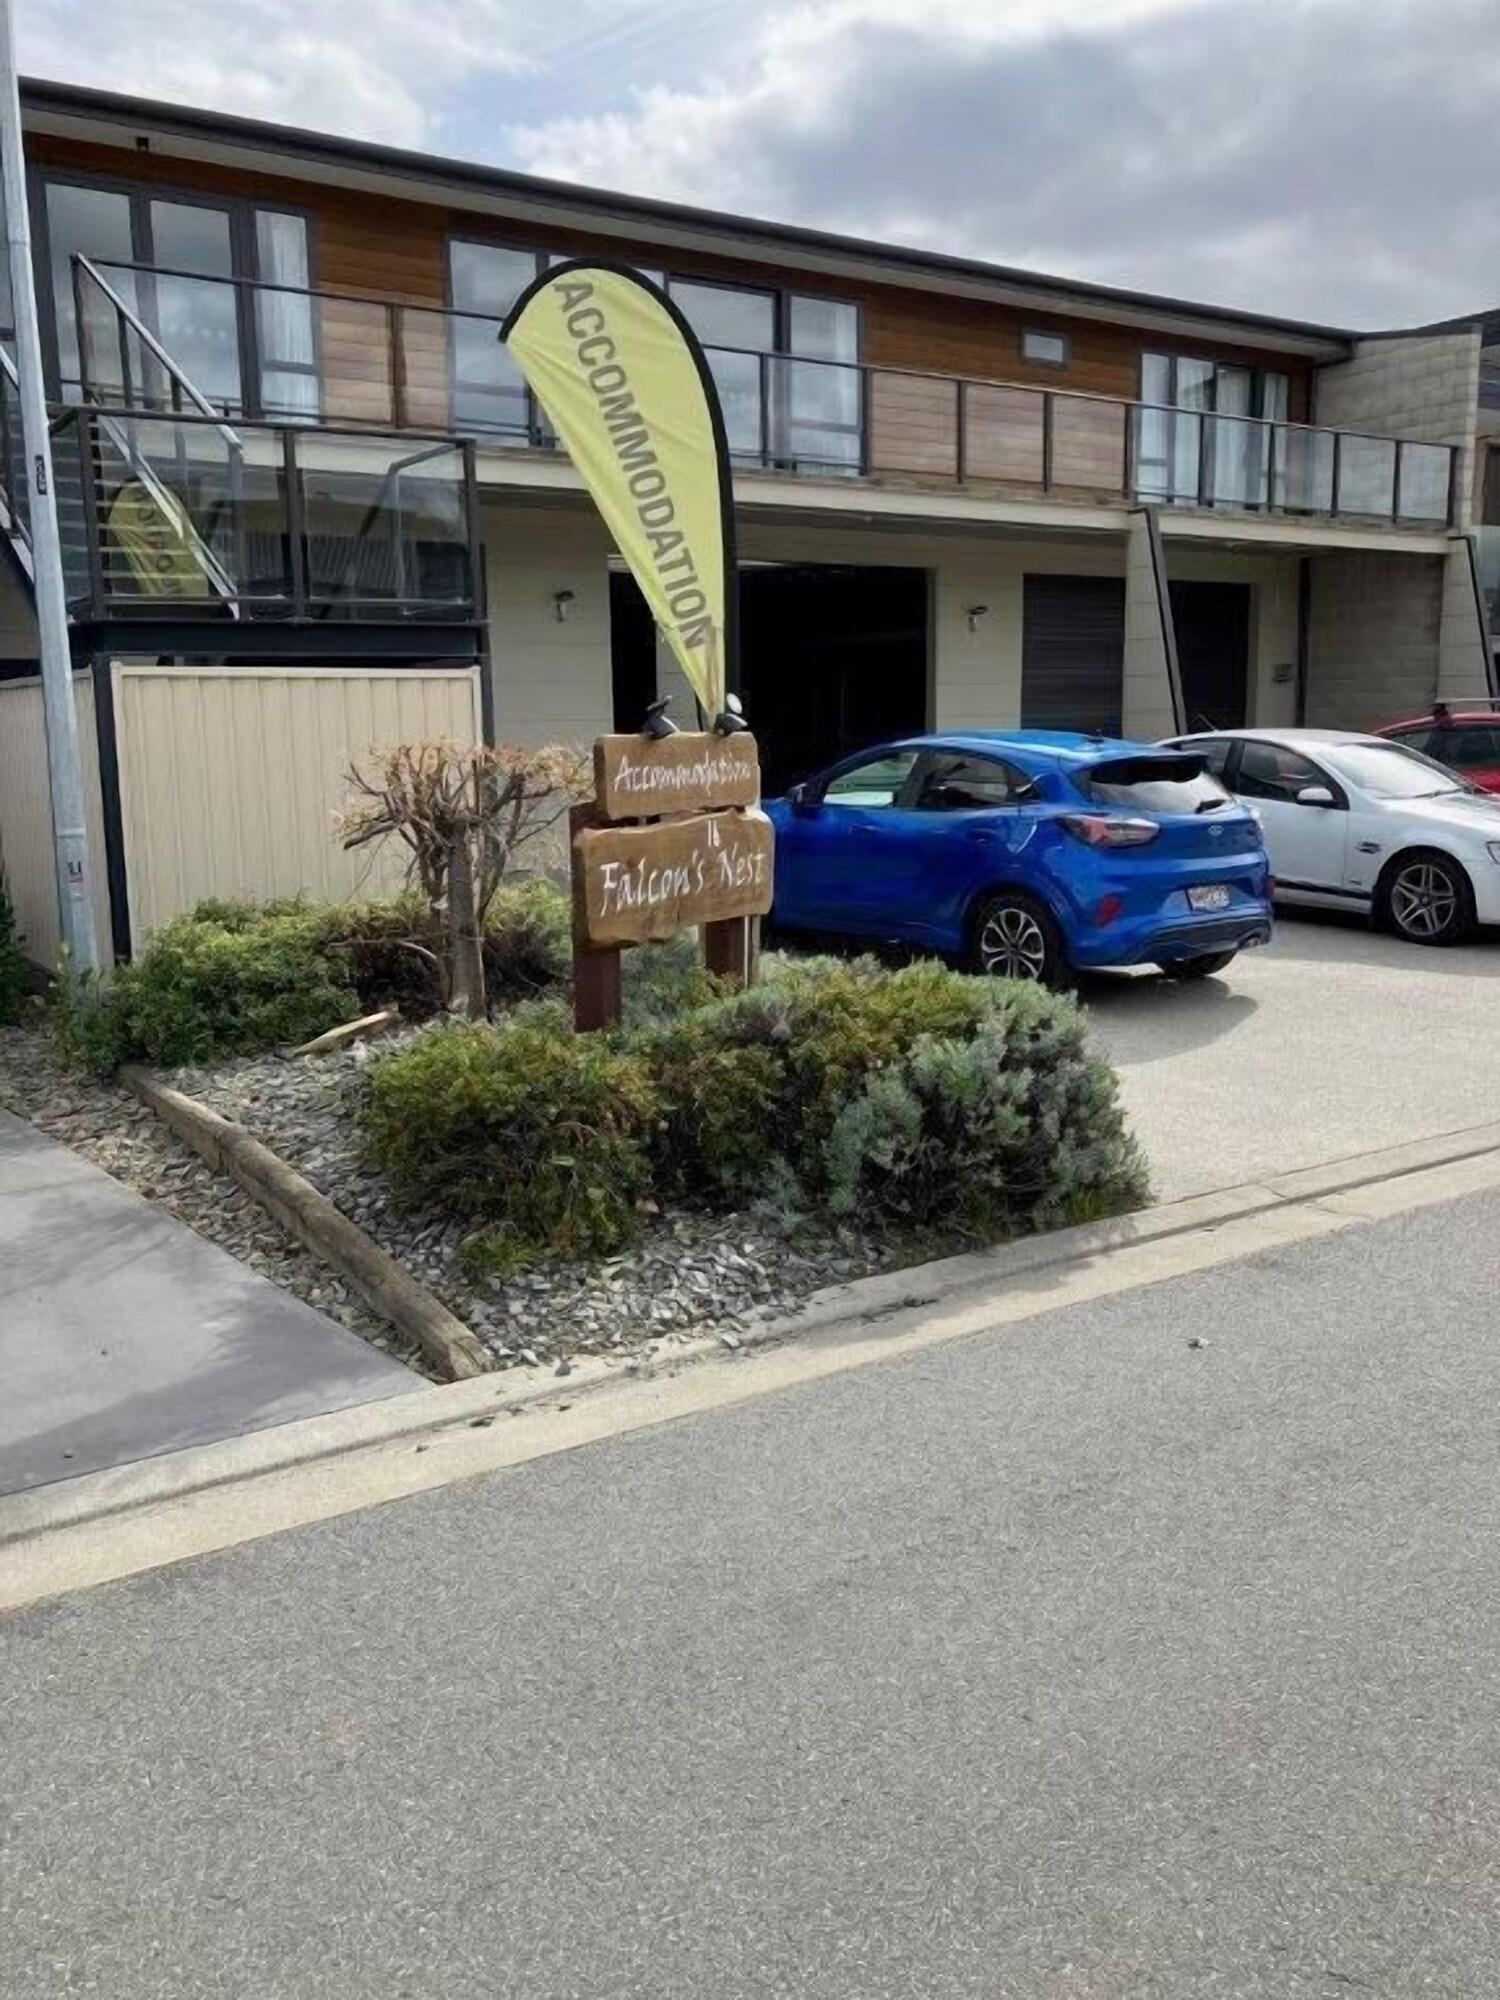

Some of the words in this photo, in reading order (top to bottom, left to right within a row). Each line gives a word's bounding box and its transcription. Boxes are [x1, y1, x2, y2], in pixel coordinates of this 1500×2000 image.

[552, 280, 717, 650] ACCOMMODATION
[600, 850, 705, 917] Falcon's
[718, 842, 766, 887] Nest
